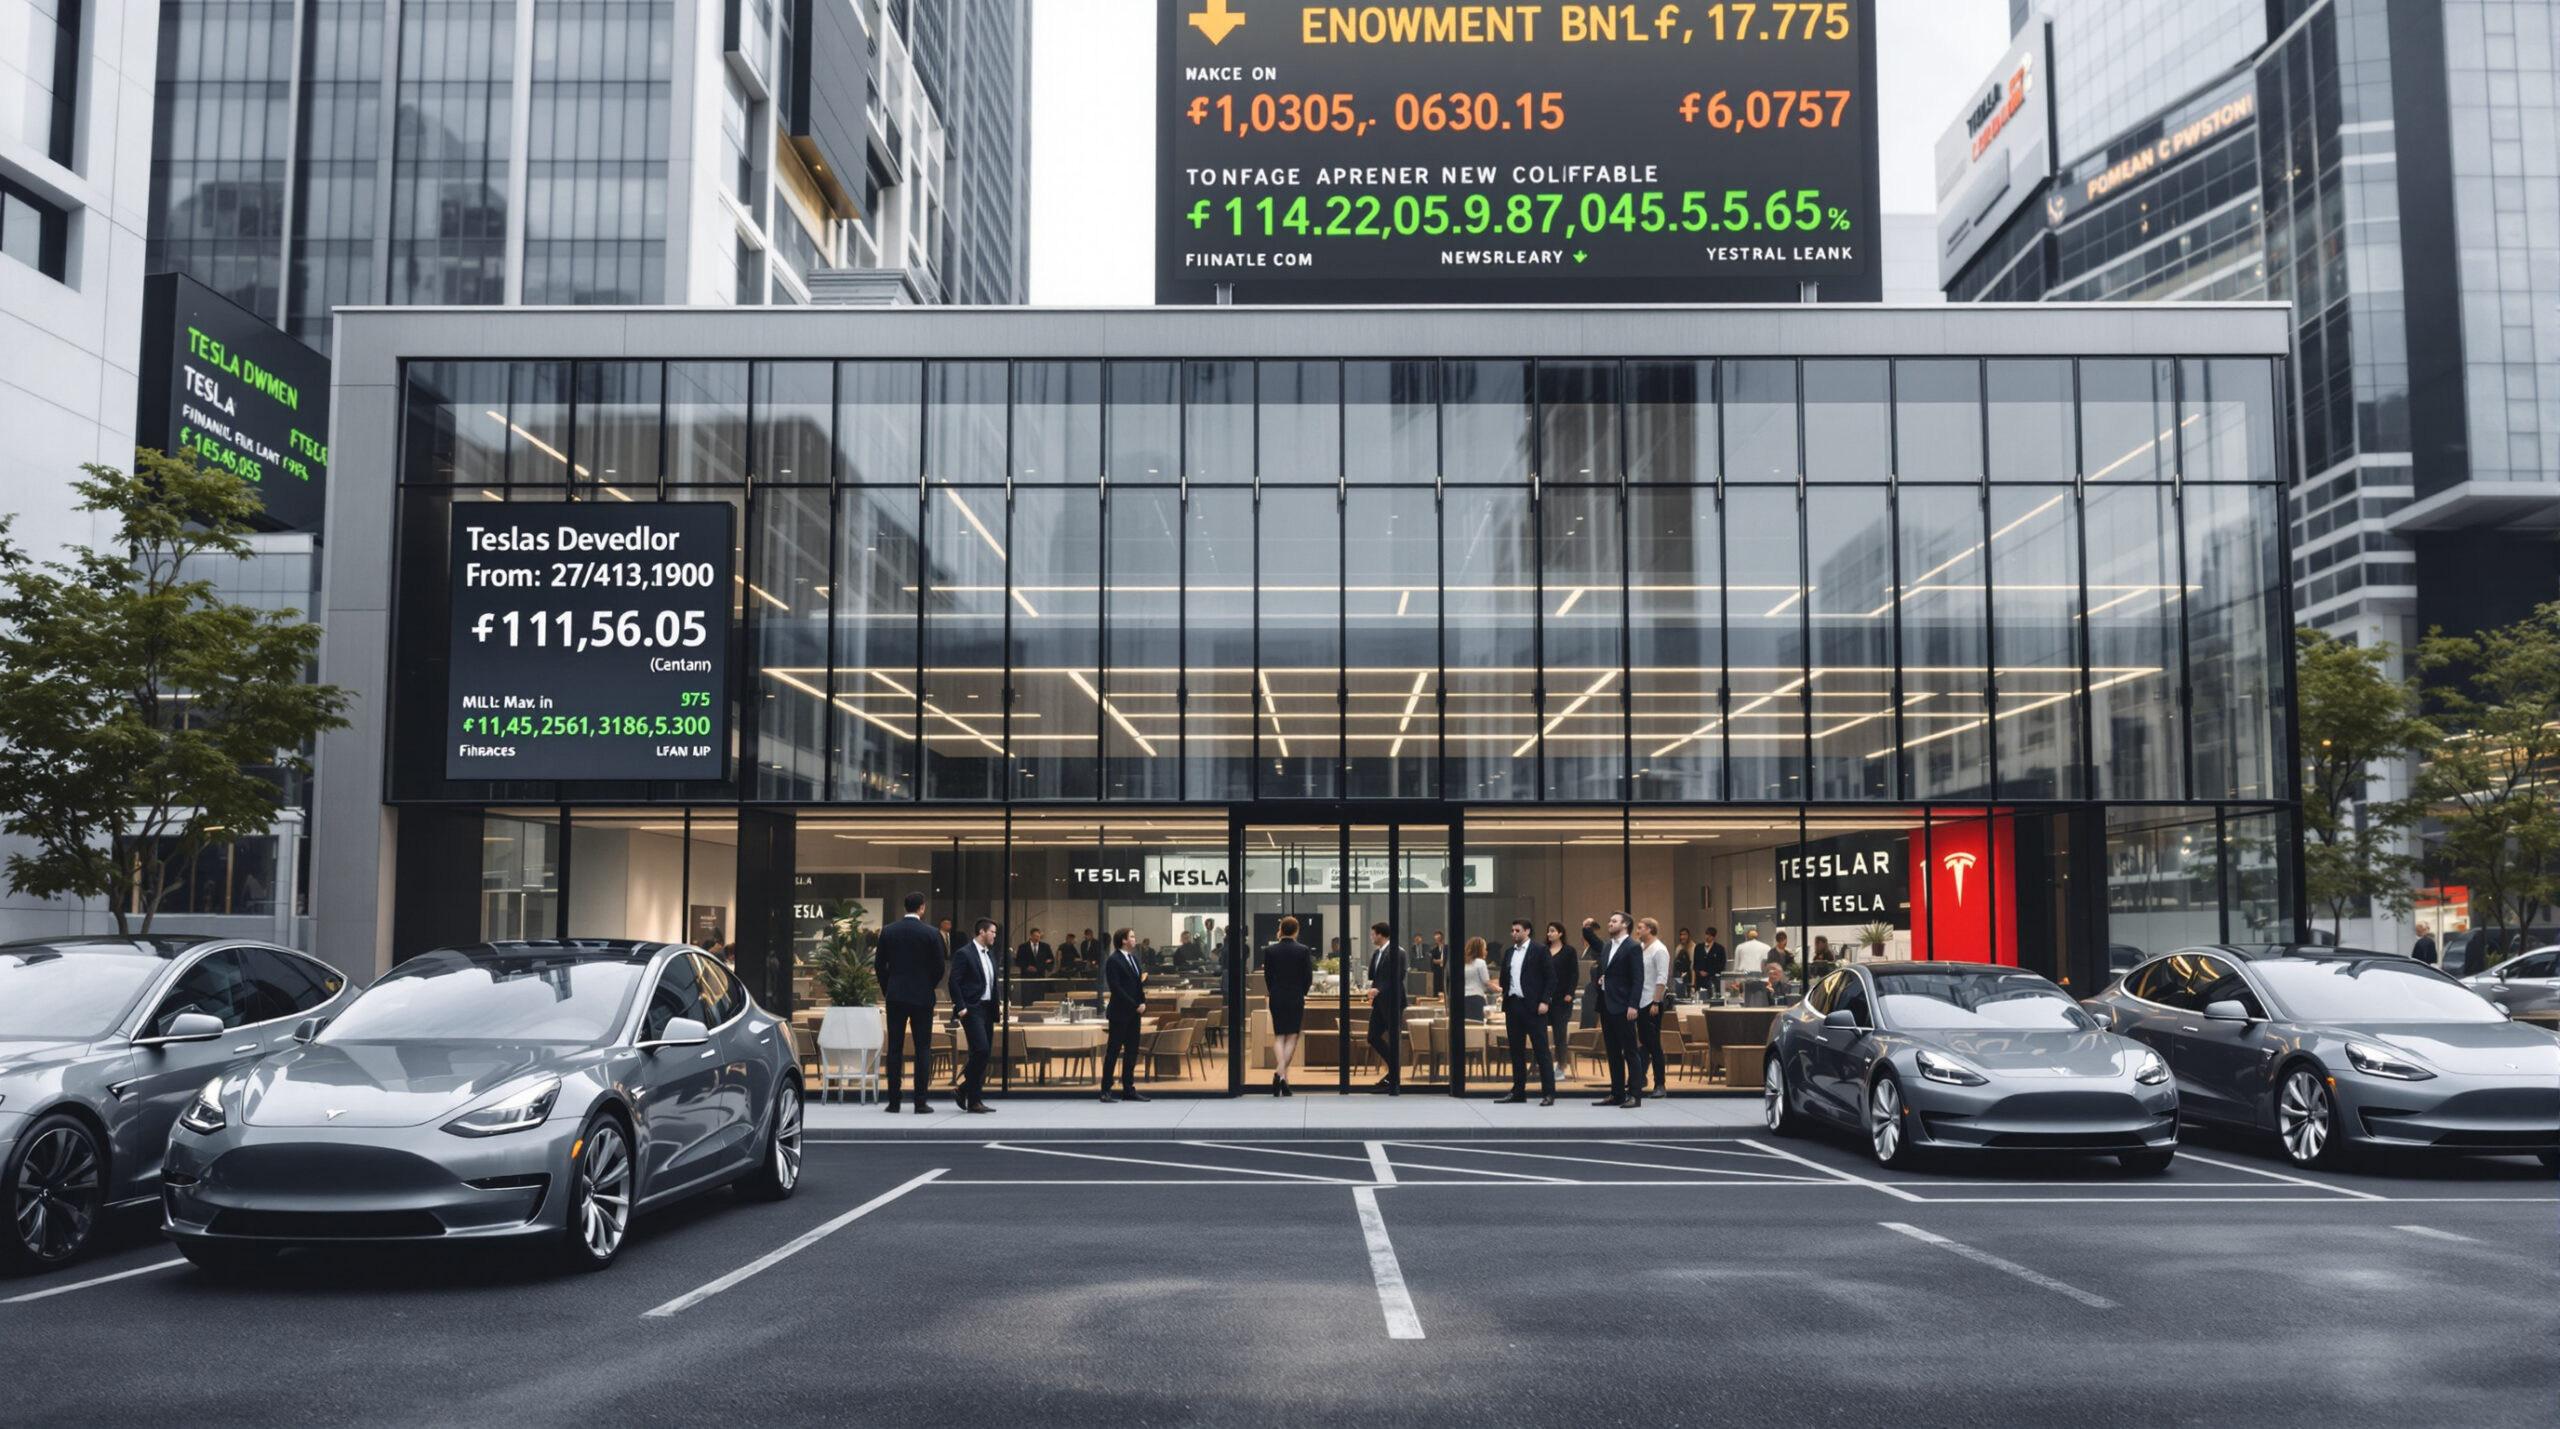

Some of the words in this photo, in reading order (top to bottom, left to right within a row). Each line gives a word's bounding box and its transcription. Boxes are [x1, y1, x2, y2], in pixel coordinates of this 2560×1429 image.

[1303, 6, 1541, 43] ENOWMENT
[1708, 3, 1849, 40] 17.775
[1252, 67, 1276, 80] ON
[1395, 92, 1564, 130] 0630.15
[1317, 167, 1428, 184] APRENER
[1443, 167, 1496, 183] NEW
[1274, 253, 1312, 266] COM
[1794, 247, 1852, 260] LEANK
[188, 326, 240, 378] TESLA
[184, 364, 236, 417] TESLA
[467, 526, 549, 551] Teslas
[558, 526, 679, 550] Devedlor
[467, 563, 540, 586] From:
[540, 696, 552, 708] in
[681, 692, 710, 706] 975
[1075, 869, 1140, 882] TESLA
[1780, 851, 1890, 881] TESSLAR
[1820, 894, 1885, 912] TESLA
